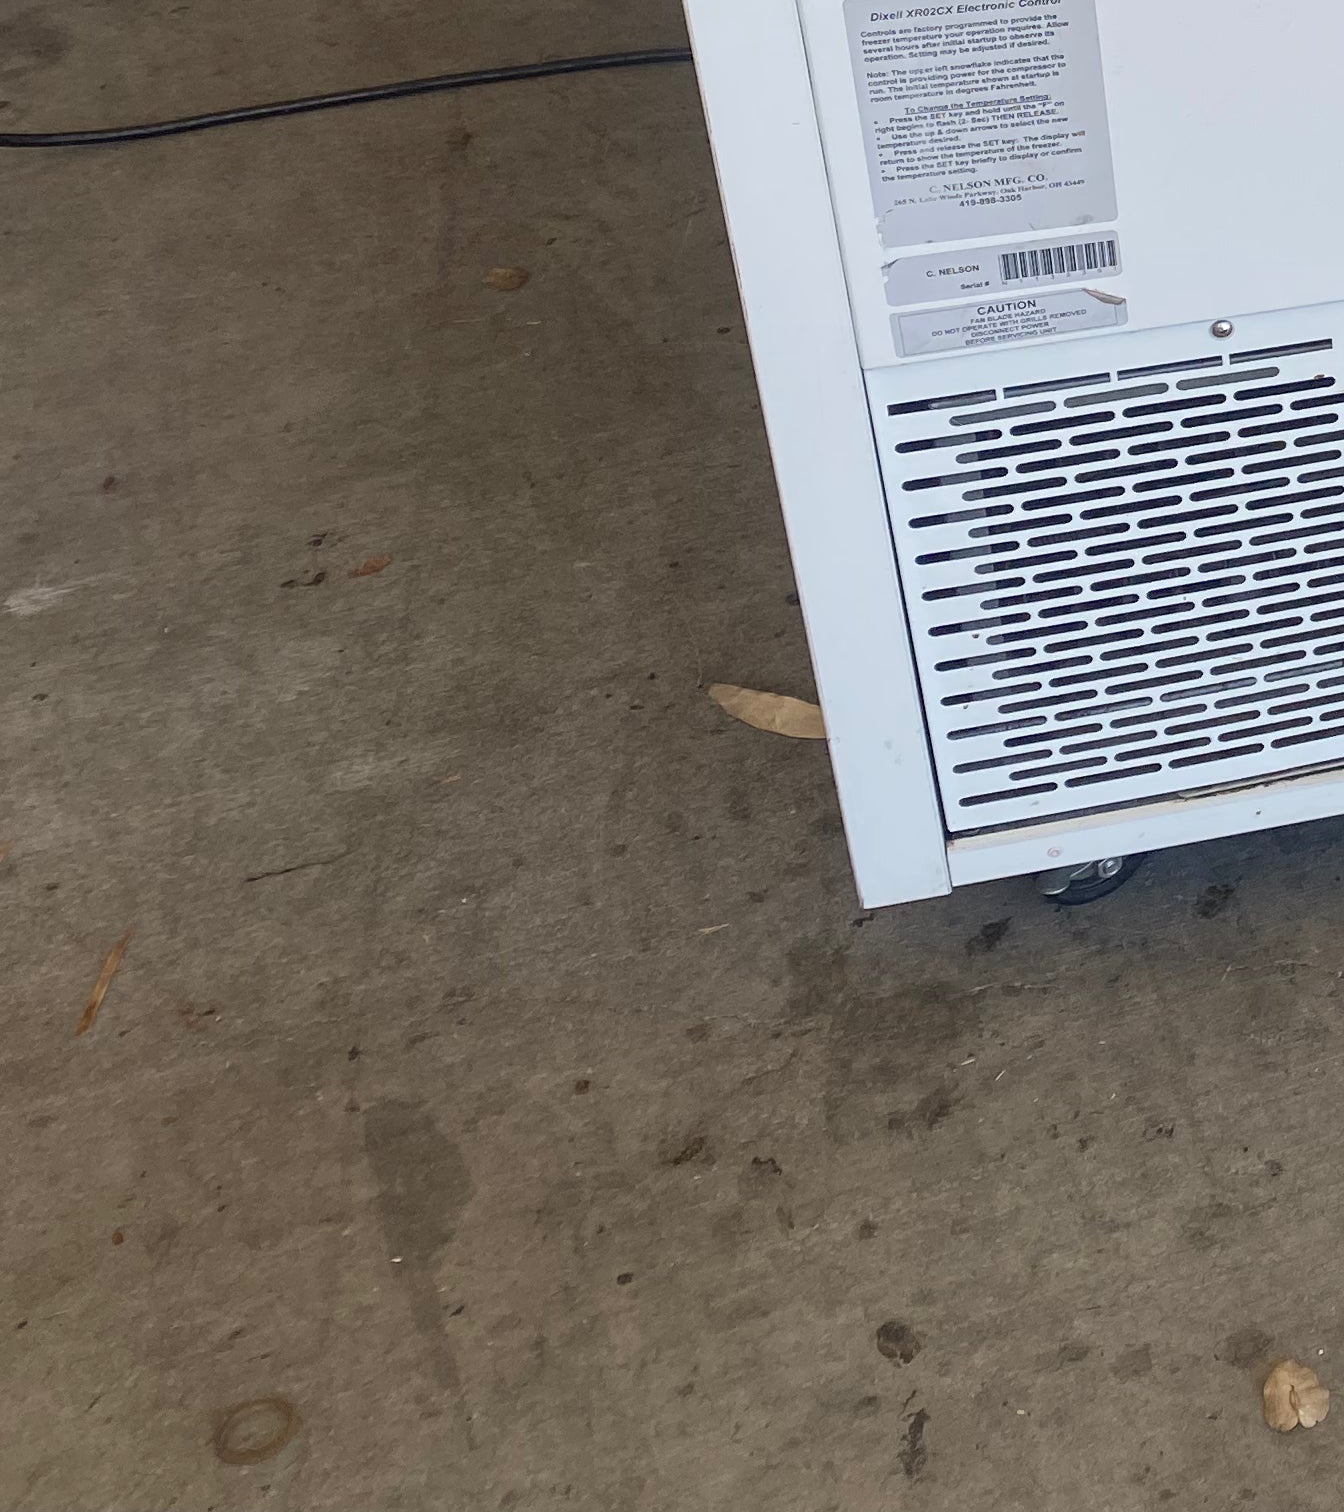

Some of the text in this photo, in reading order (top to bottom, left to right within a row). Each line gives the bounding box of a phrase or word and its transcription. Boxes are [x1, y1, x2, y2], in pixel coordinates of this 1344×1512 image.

[869, 10, 903, 22] Dixell
[905, 5, 953, 18] XR02CX
[955, 0, 1015, 14] Electronic
[860, 27, 896, 39] Controls
[913, 23, 942, 34] factory
[944, 18, 998, 31] programmed
[1010, 14, 1042, 24] provide
[1043, 12, 1056, 20] the
[942, 179, 991, 192] NELSON
[1027, 172, 1048, 182] CO.
[938, 264, 979, 276] NELSON
[960, 281, 983, 290] Serial
[976, 299, 1036, 315] CAUTION
[944, 327, 961, 335] NOT
[962, 322, 997, 332] OPERATE
[999, 319, 1018, 327] WITH
[1049, 309, 1086, 319] REMOVED
[970, 308, 1046, 324] FAN BLADE HAZARD
[971, 321, 1049, 338] DISCONNECT POWER
